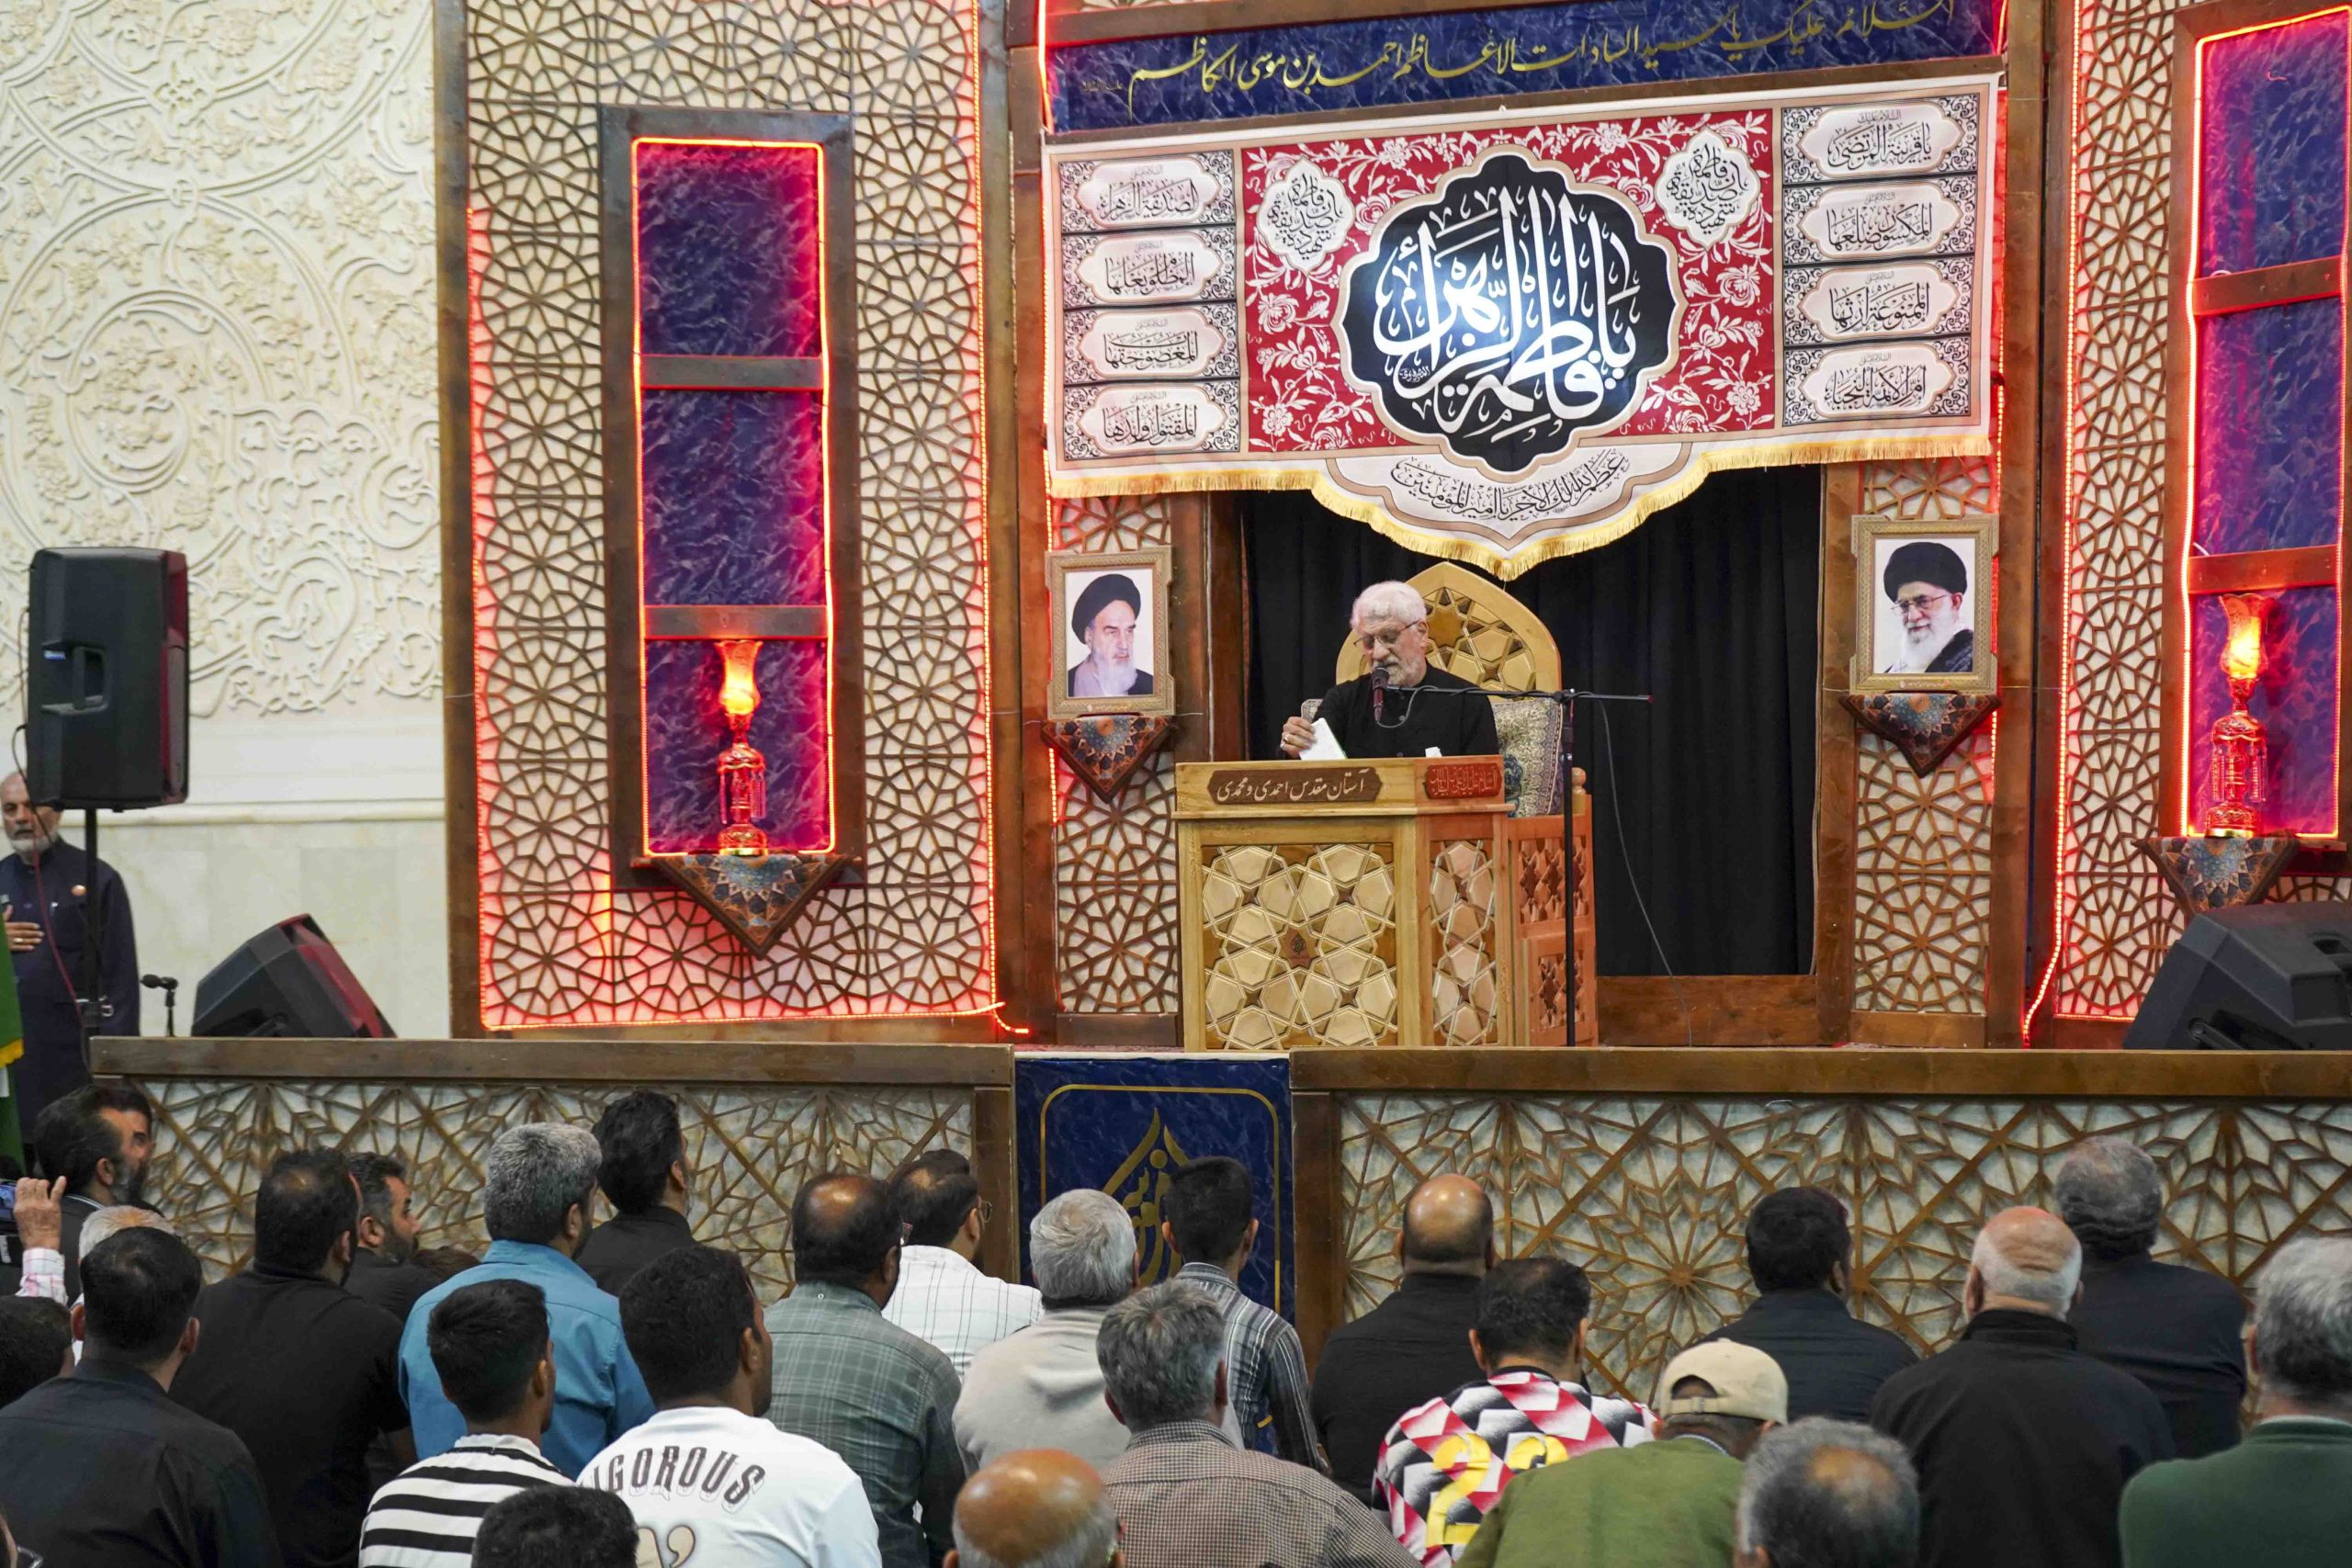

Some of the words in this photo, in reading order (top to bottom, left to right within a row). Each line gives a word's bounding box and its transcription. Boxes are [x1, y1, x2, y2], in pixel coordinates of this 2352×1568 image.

[1283, 51, 1317, 96] بن
[1308, 41, 1402, 87] احمد
[1289, 777, 1327, 801] مقدس
[1327, 768, 1370, 801] آستان
[579, 1444, 766, 1512] IGOROUS
